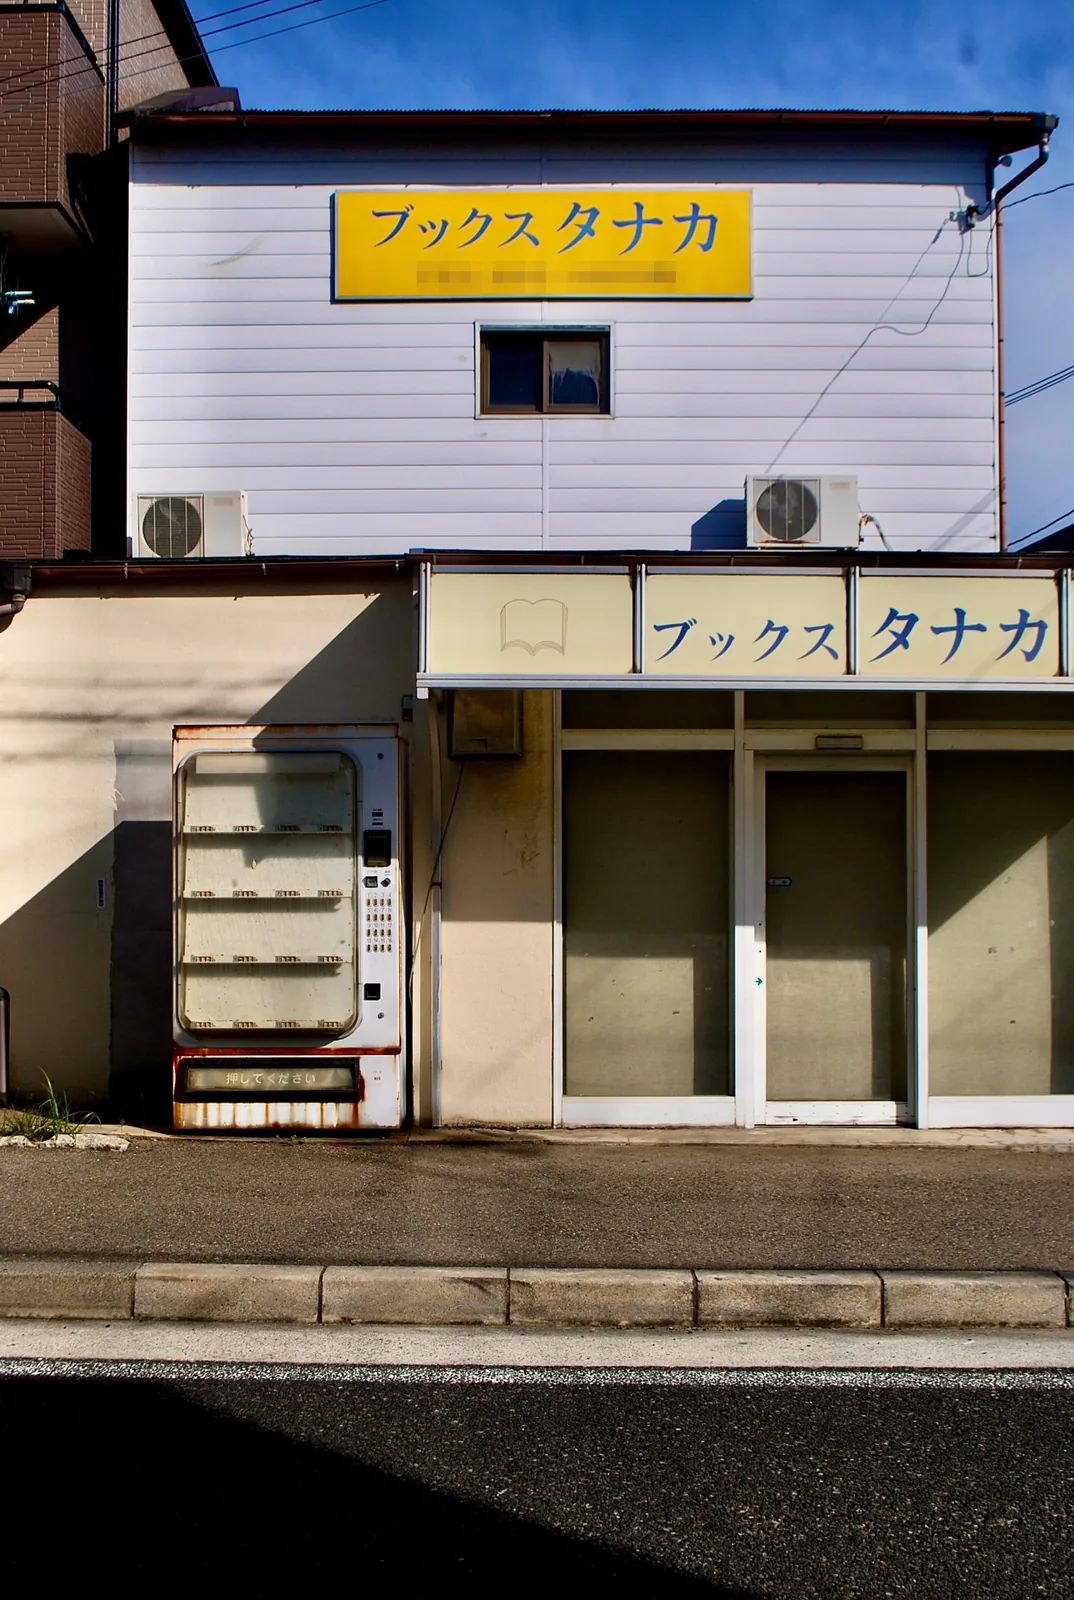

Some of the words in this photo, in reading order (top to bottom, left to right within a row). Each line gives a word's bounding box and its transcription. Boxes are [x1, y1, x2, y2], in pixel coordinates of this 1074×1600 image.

[372, 202, 719, 255] ブックスタナカ
[226, 1072, 316, 1085] 押してください
